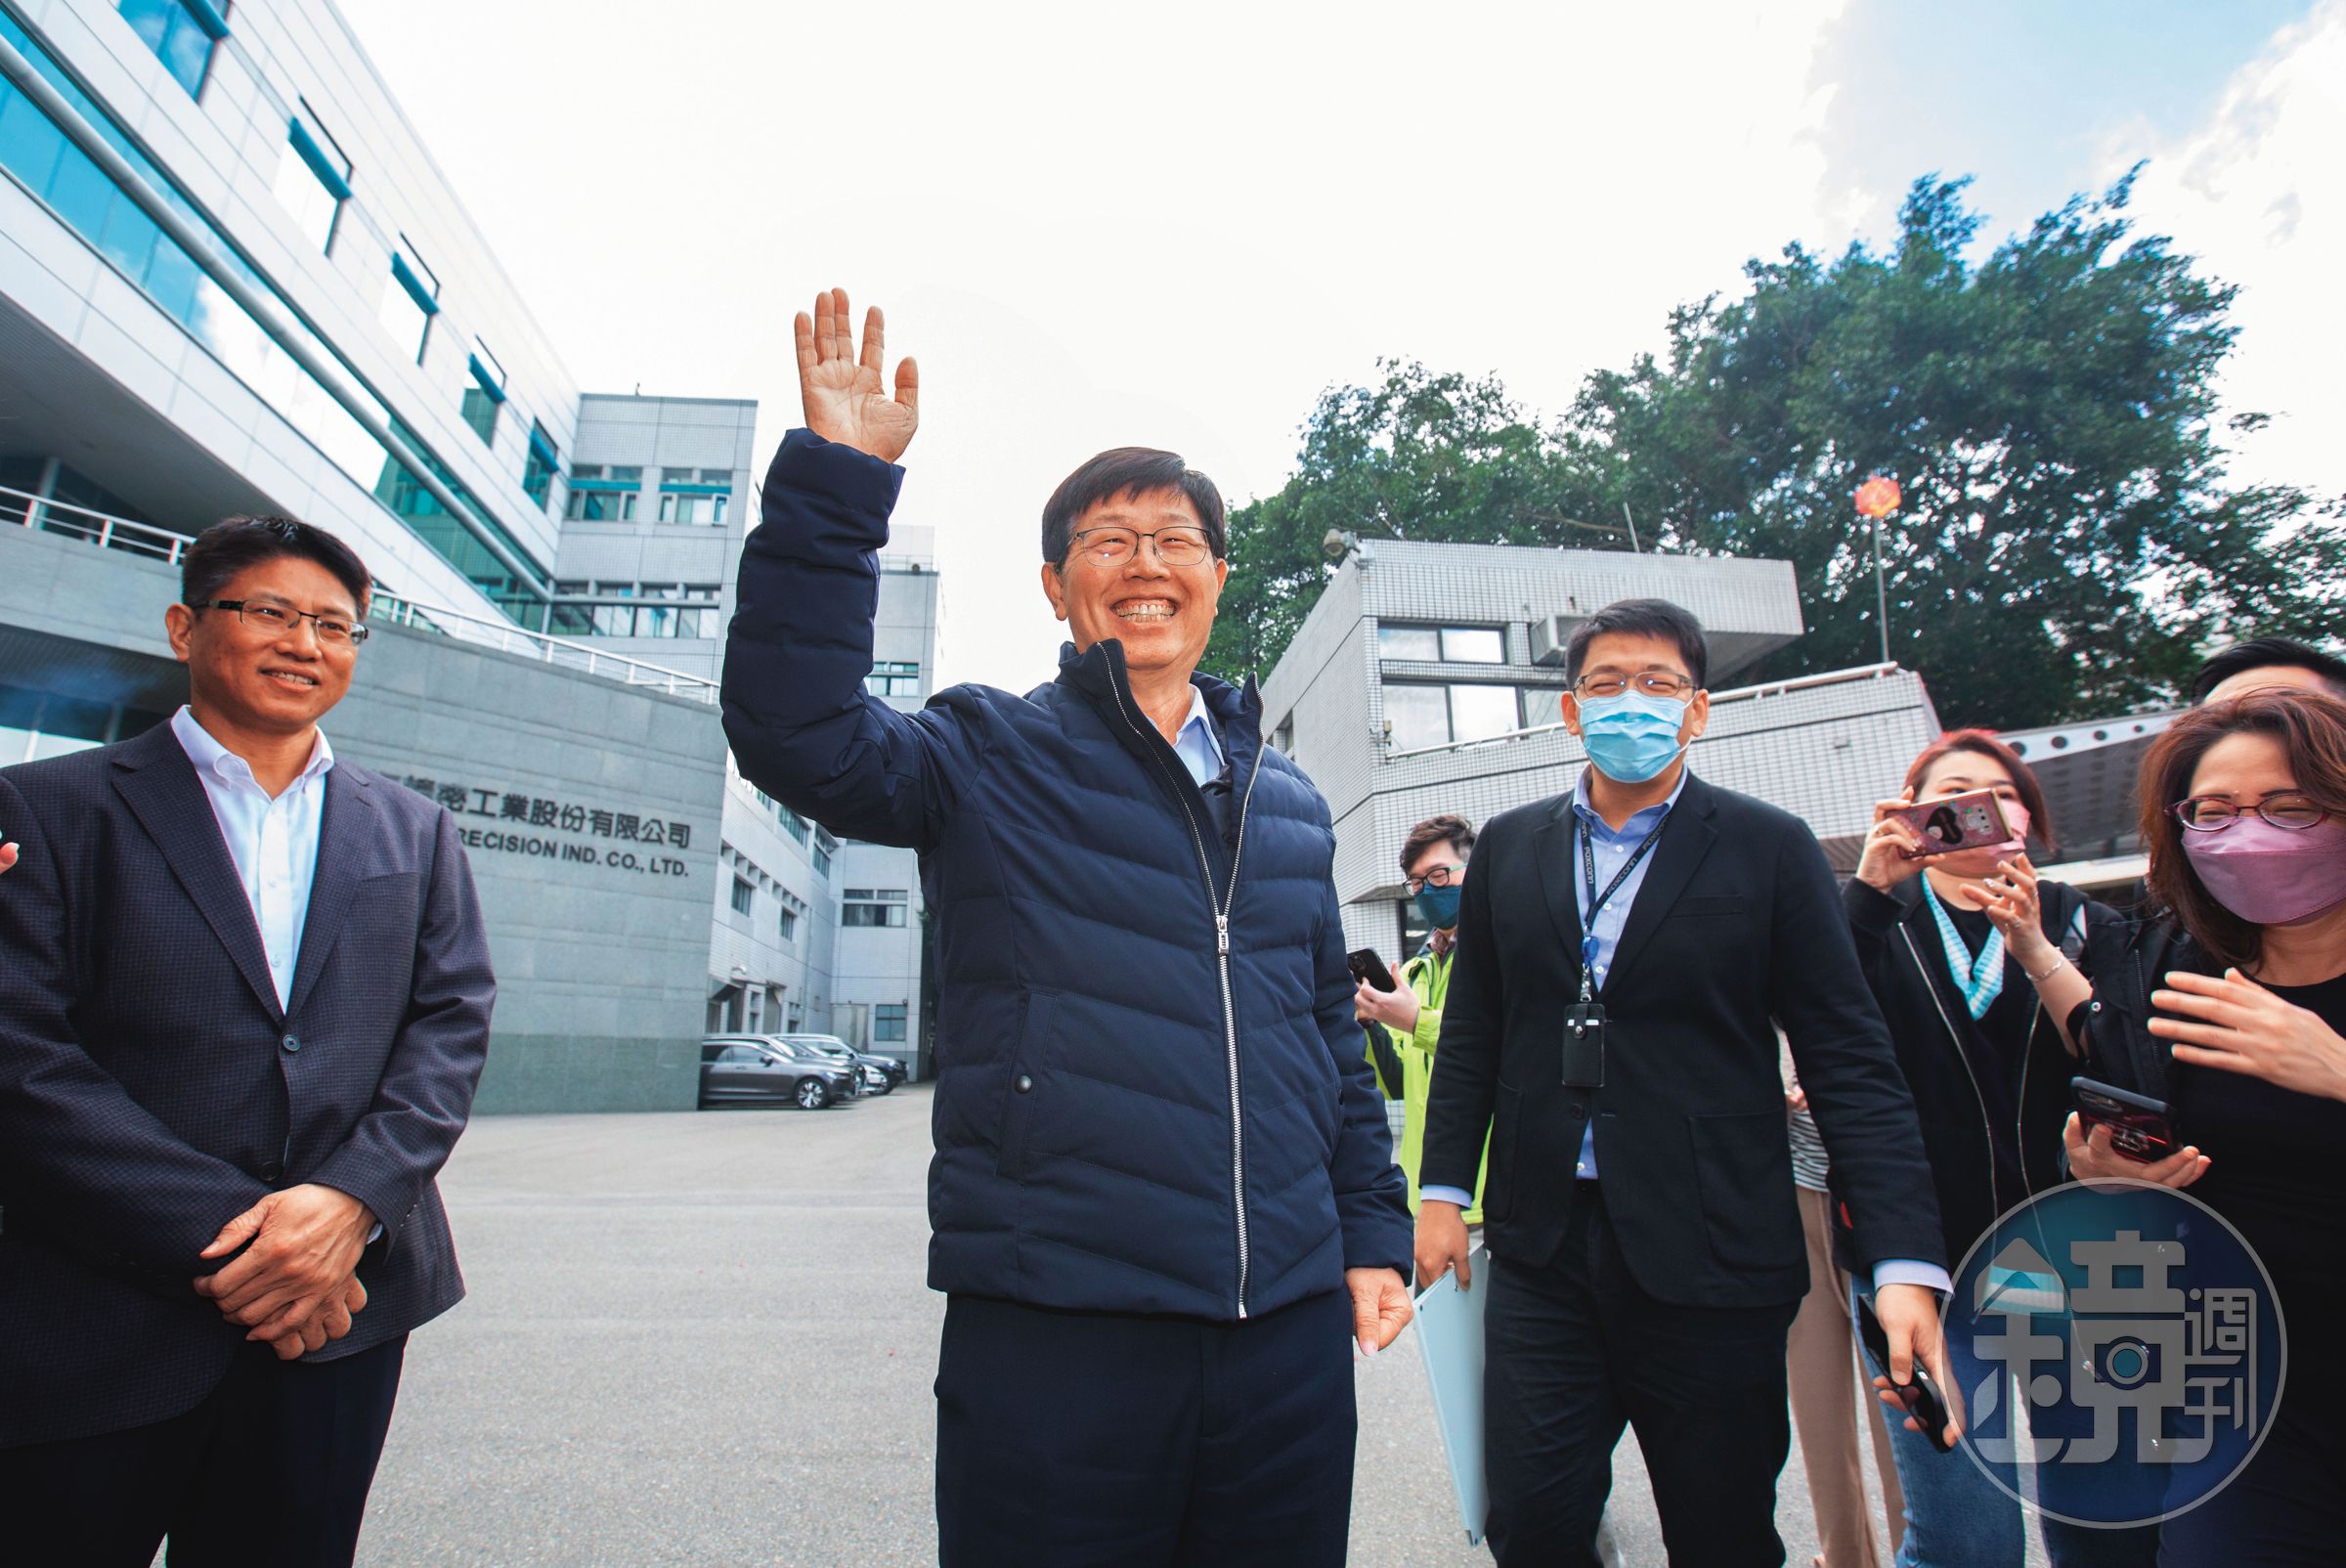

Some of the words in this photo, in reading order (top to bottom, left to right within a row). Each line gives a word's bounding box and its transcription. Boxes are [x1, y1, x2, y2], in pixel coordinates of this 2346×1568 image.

[379, 772, 691, 849] 密工業股份有限公司
[457, 827, 557, 858] RECISION
[561, 844, 602, 866] IND.
[606, 851, 645, 874] CO.,
[650, 857, 689, 878] LTD.
